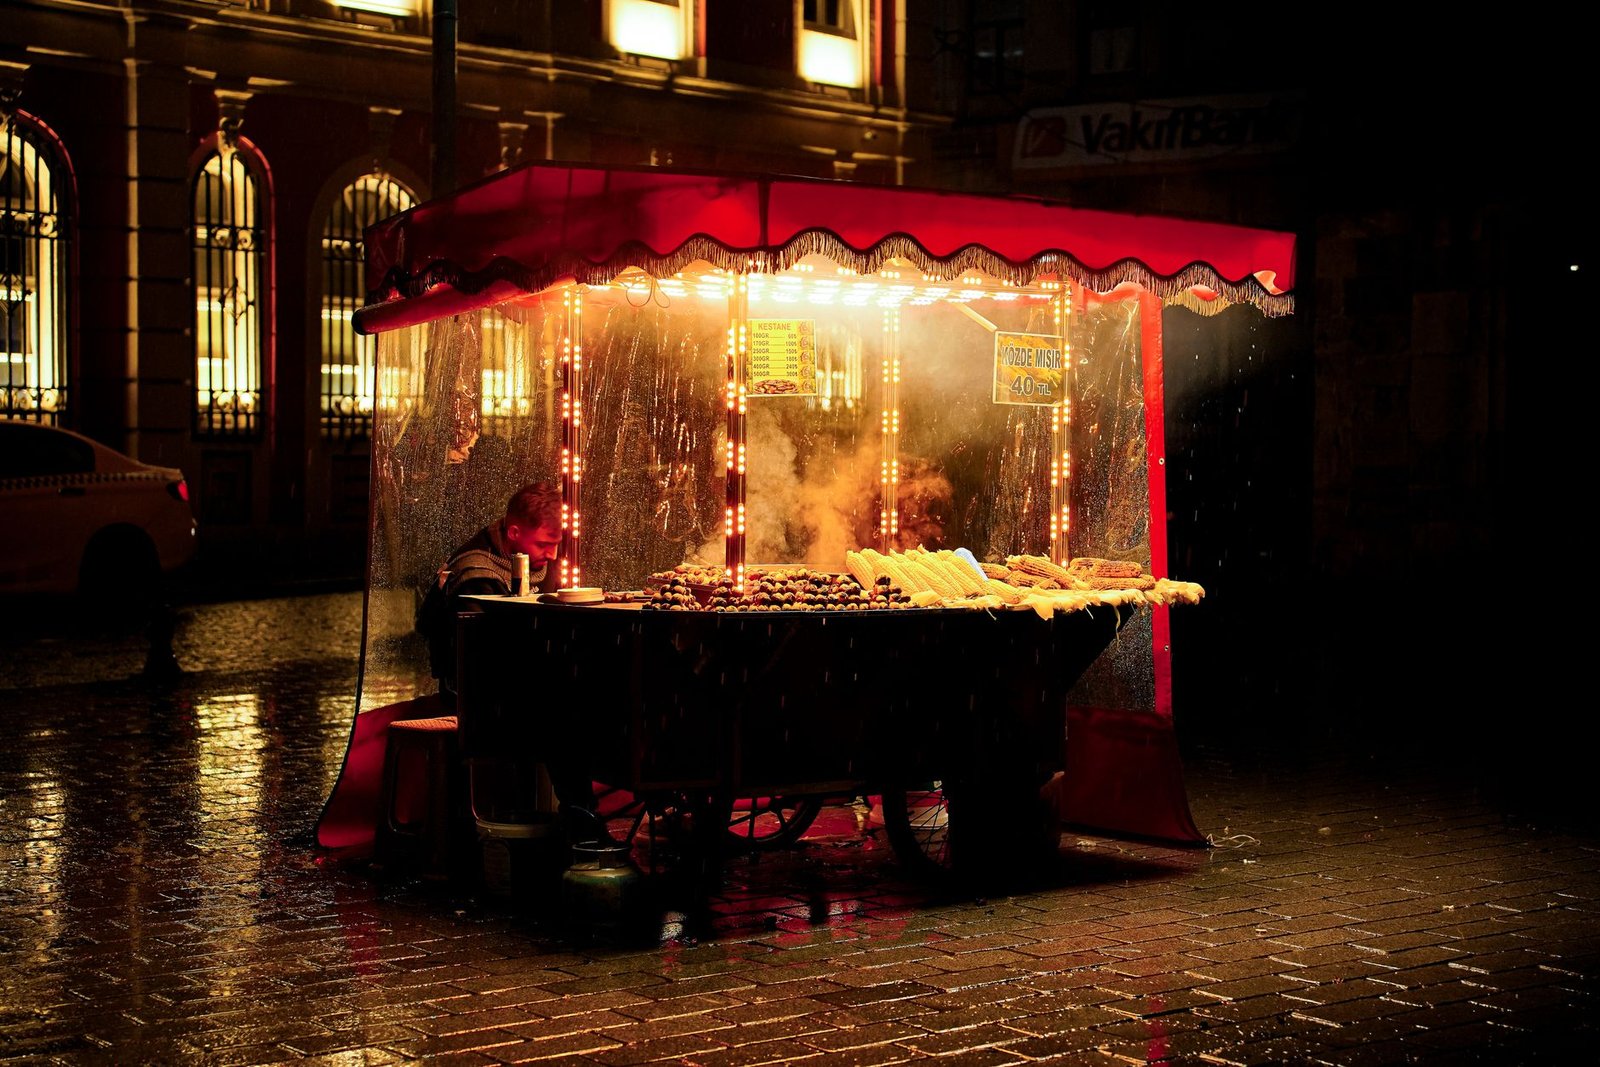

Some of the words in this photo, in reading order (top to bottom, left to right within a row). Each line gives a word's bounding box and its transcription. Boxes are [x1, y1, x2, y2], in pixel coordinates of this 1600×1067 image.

[758, 323, 791, 331] KESTANE
[1002, 343, 1033, 367] KÖZDE
[1035, 348, 1061, 369] MISIR
[1011, 375, 1034, 395] 40
[1037, 384, 1051, 395] TL
